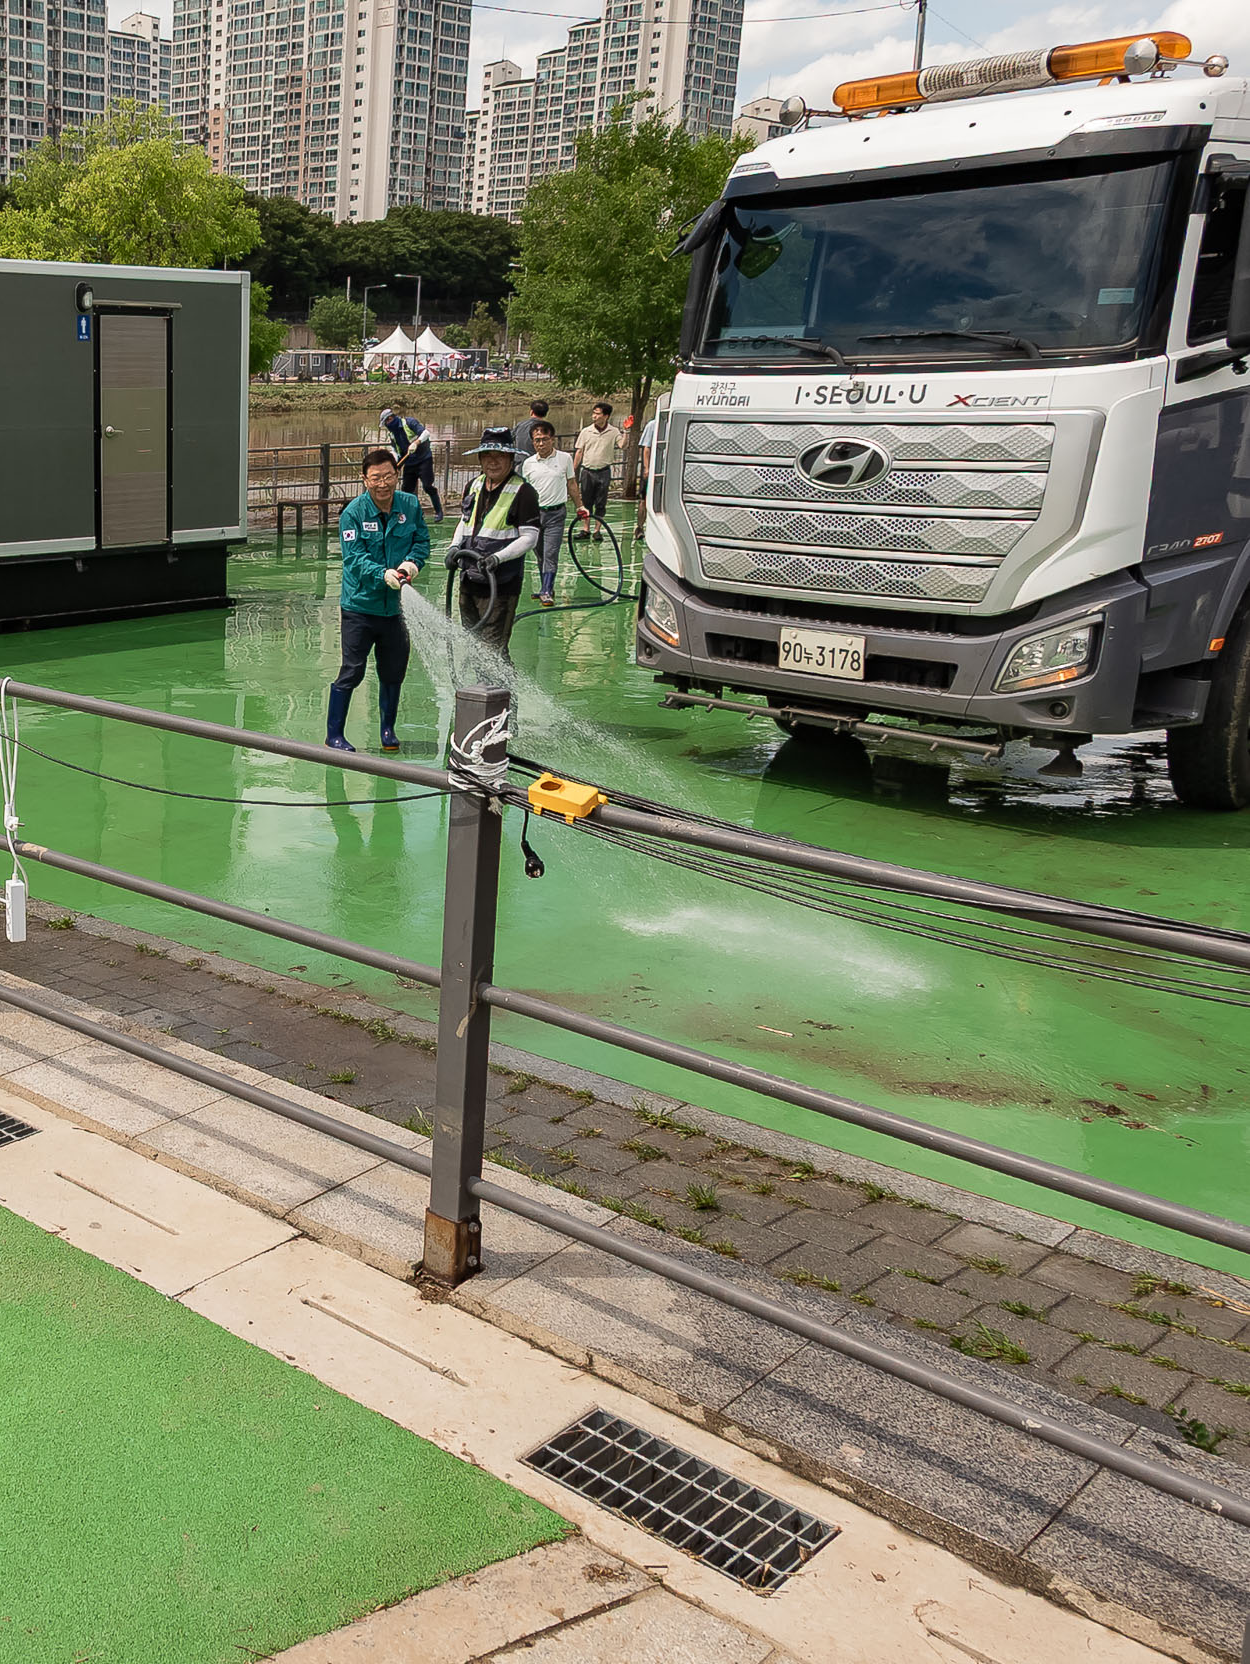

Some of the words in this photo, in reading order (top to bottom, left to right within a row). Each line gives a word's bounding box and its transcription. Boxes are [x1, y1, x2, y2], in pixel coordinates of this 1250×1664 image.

[709, 382, 737, 395] 광진구
[696, 395, 751, 407] HYUNDAI
[946, 394, 1048, 408] XCIENT
[782, 641, 861, 672] 90누3178
